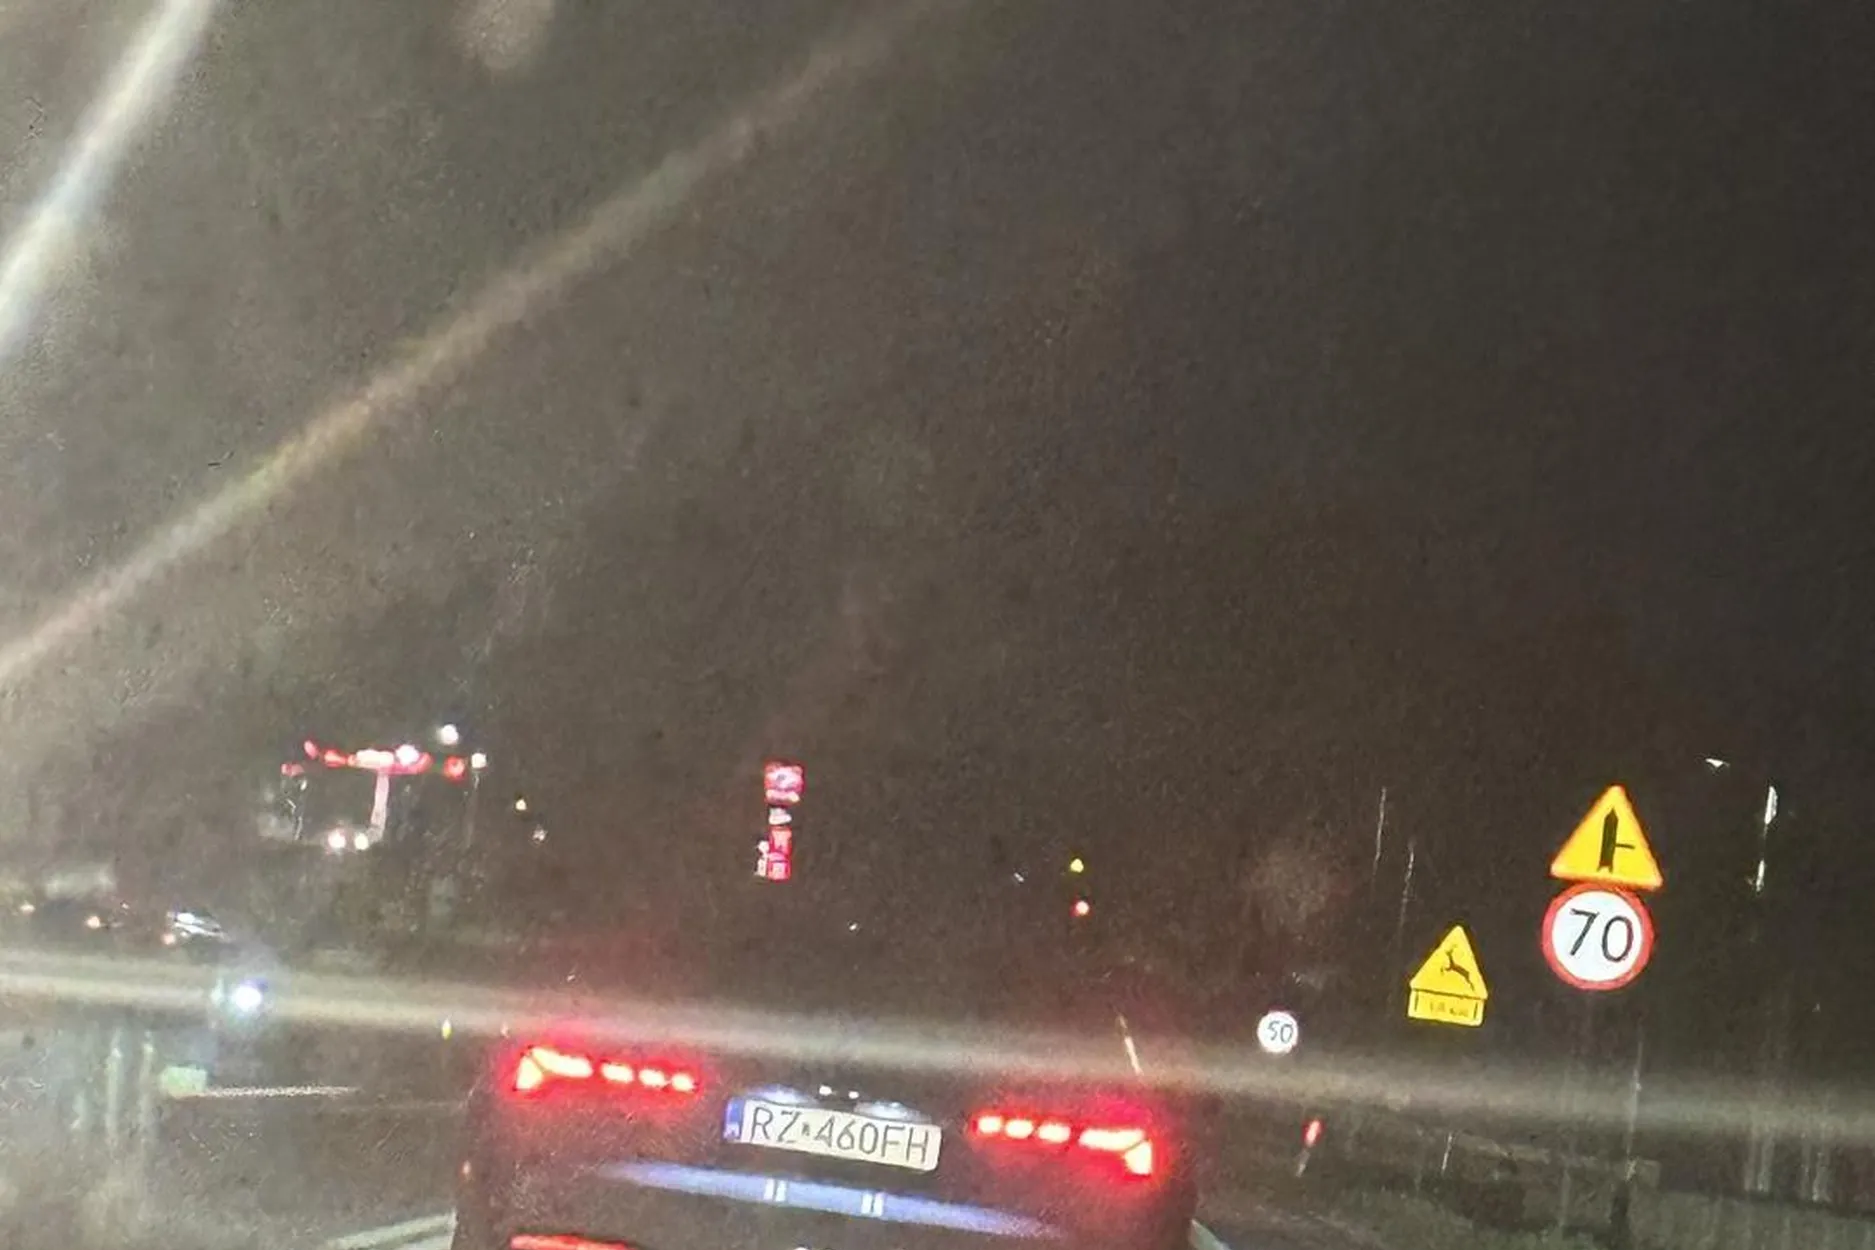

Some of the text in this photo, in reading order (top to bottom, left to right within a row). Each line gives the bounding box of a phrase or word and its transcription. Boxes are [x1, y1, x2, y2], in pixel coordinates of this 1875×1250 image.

[1569, 907, 1634, 963] 70
[1267, 1020, 1294, 1044] 50
[750, 1106, 929, 1164] RZ 460FH
